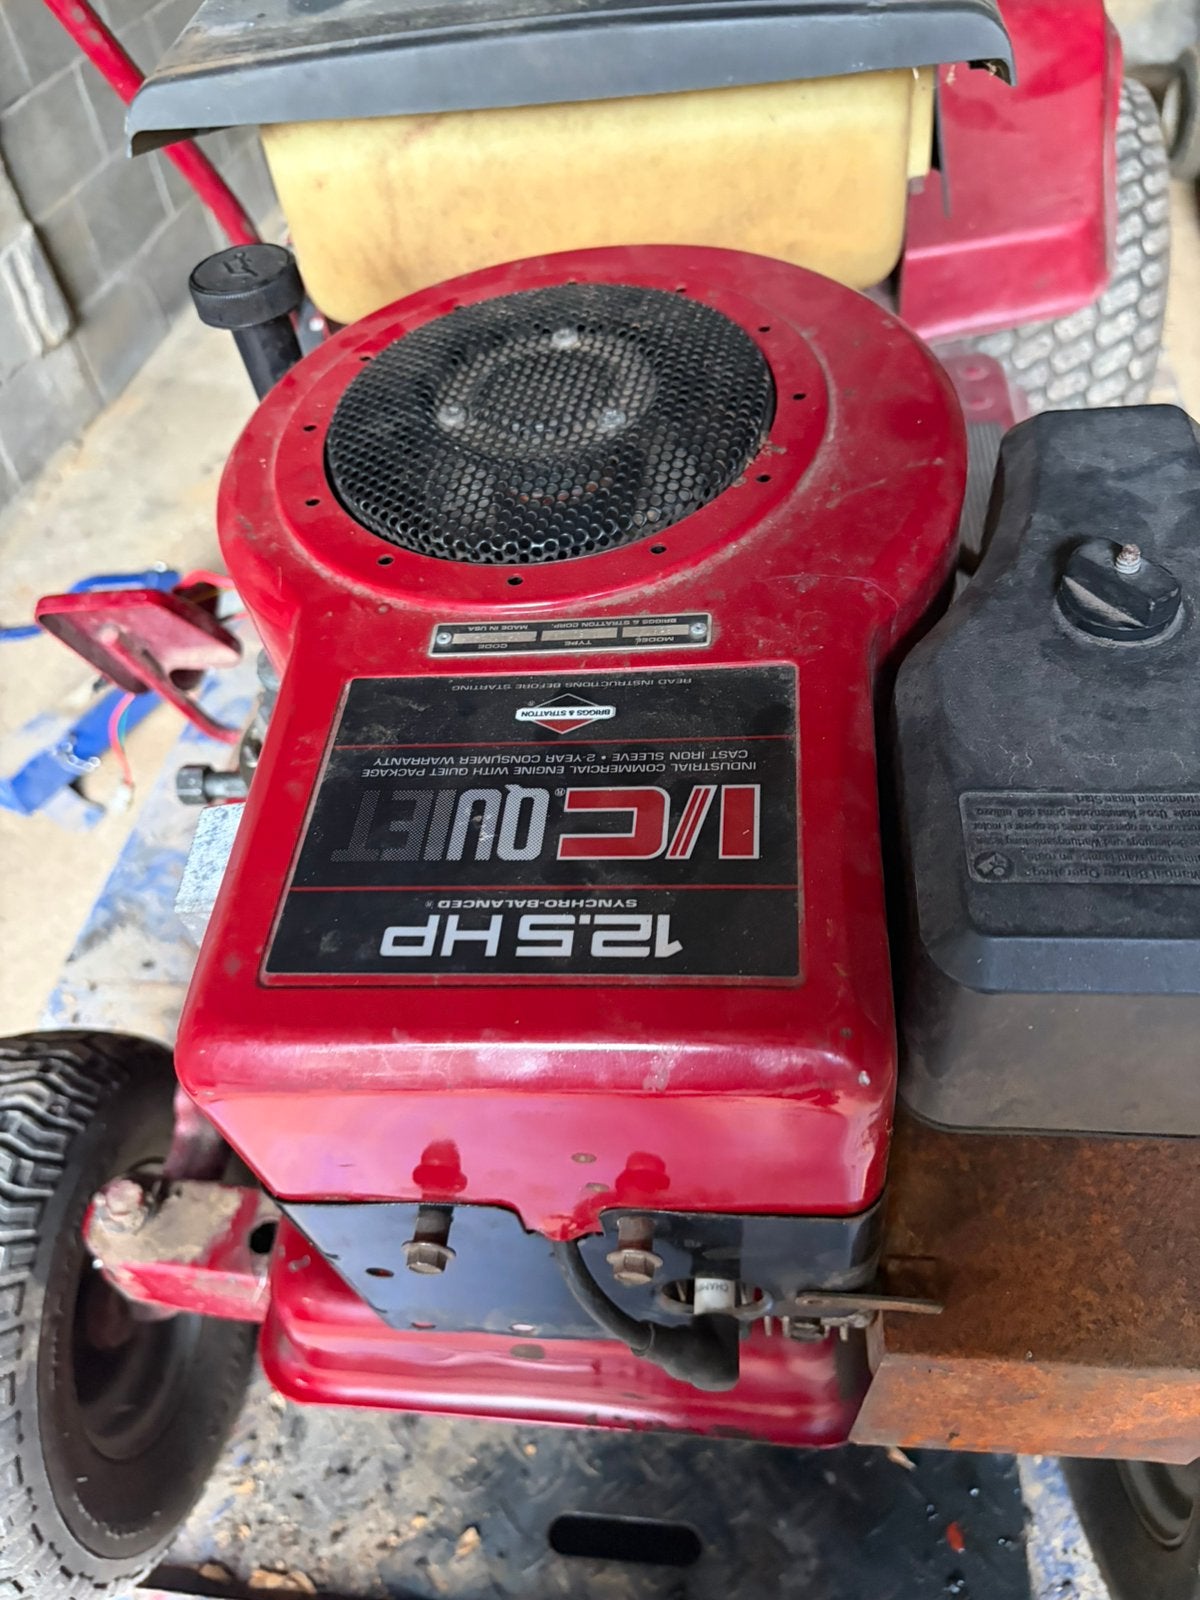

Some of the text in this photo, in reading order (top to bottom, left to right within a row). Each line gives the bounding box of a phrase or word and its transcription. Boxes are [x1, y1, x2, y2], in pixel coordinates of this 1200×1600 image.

[581, 620, 631, 628] STRATTON
[451, 683, 512, 692] STARTING
[515, 682, 561, 690] BEFORE
[564, 679, 654, 688] INSTRUCTIONS
[520, 708, 611, 718] BRIGGS & STRATTON
[372, 749, 749, 766] CAST IRON SLEEVE 2-YEAR CONSUMER WARRANTY
[360, 760, 757, 778] INDUSTRIAL COMMERCIAL ENGINE WITH QUIET PACKAGE
[329, 784, 550, 862] QUIET
[437, 898, 638, 909] SYNCHRO-BALANCED
[379, 914, 683, 958] 12.5 HP
